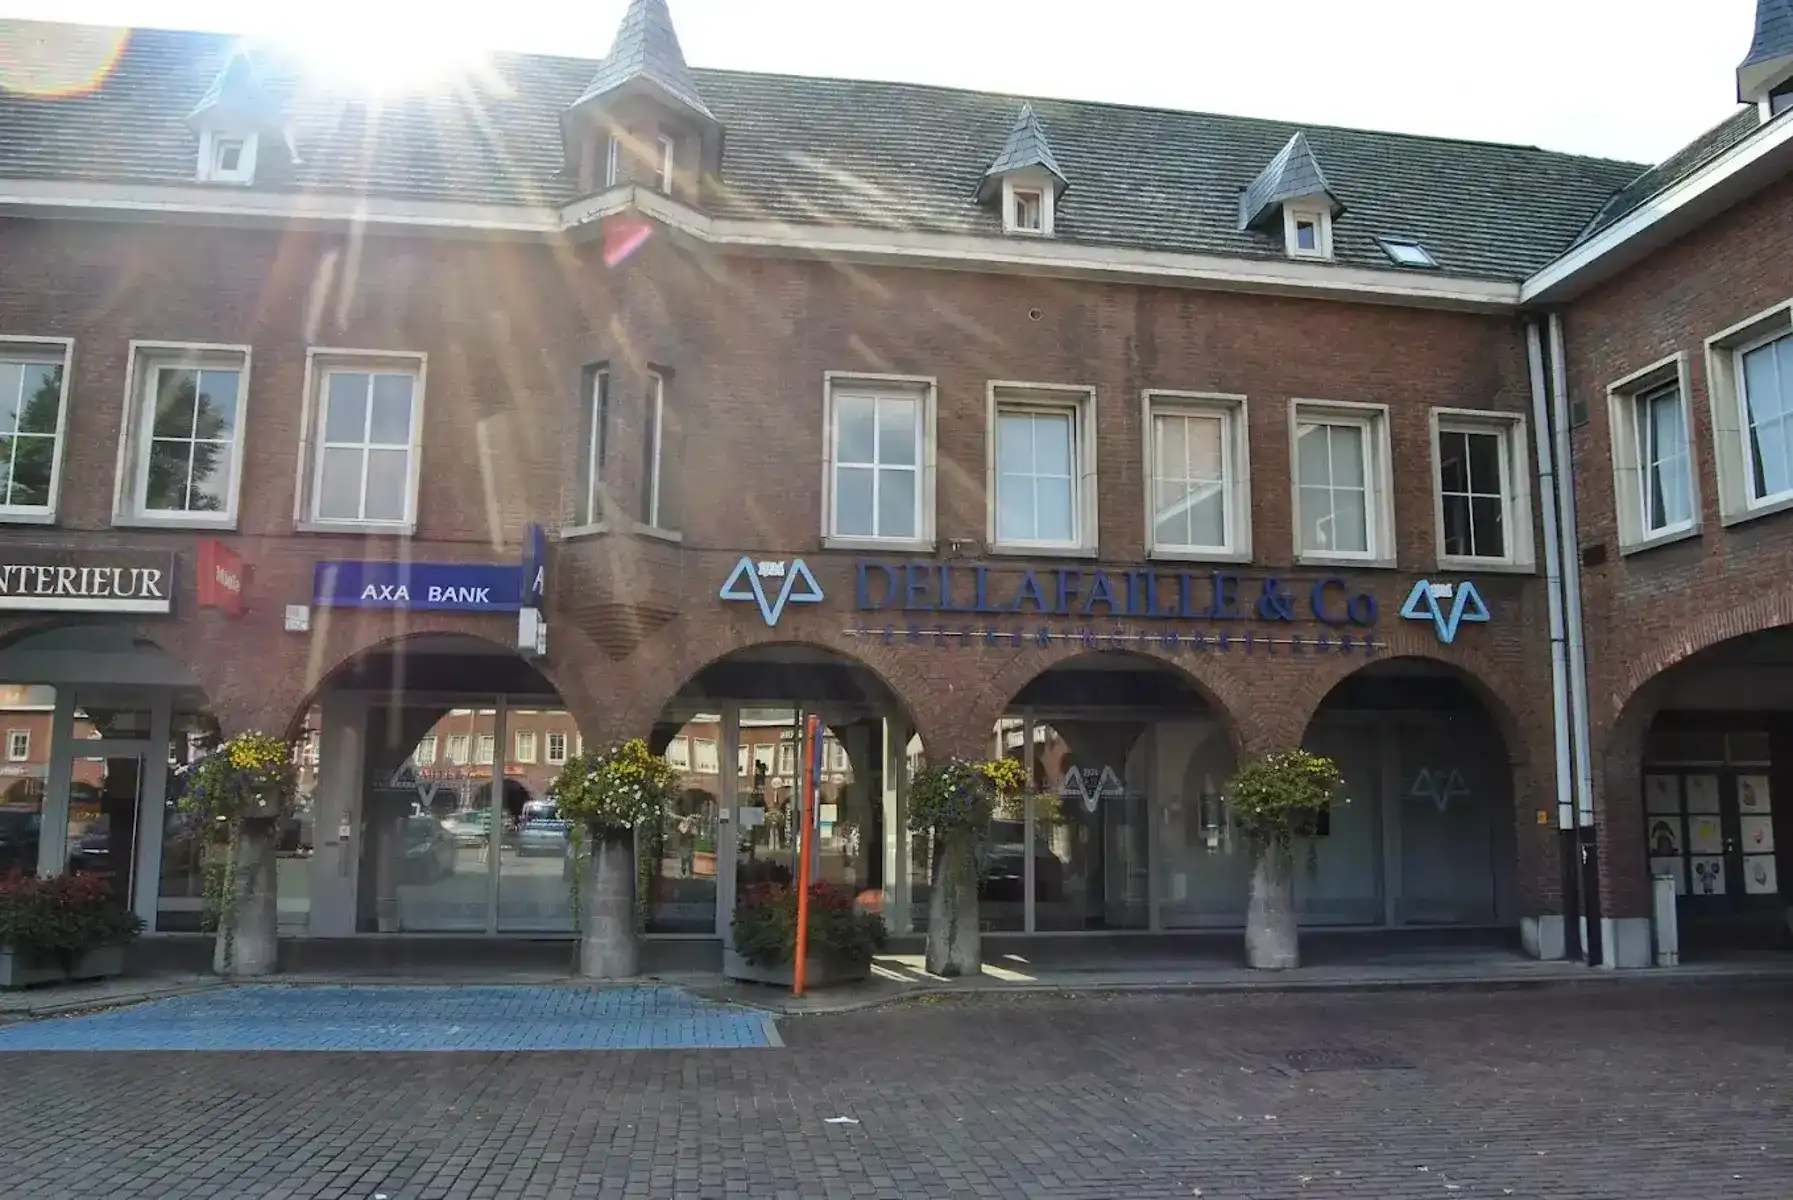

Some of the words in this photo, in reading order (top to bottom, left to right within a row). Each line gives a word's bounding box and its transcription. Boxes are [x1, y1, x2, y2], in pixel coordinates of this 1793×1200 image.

[360, 584, 410, 601] AXA
[427, 586, 490, 604] BANK
[1257, 575, 1296, 622] &
